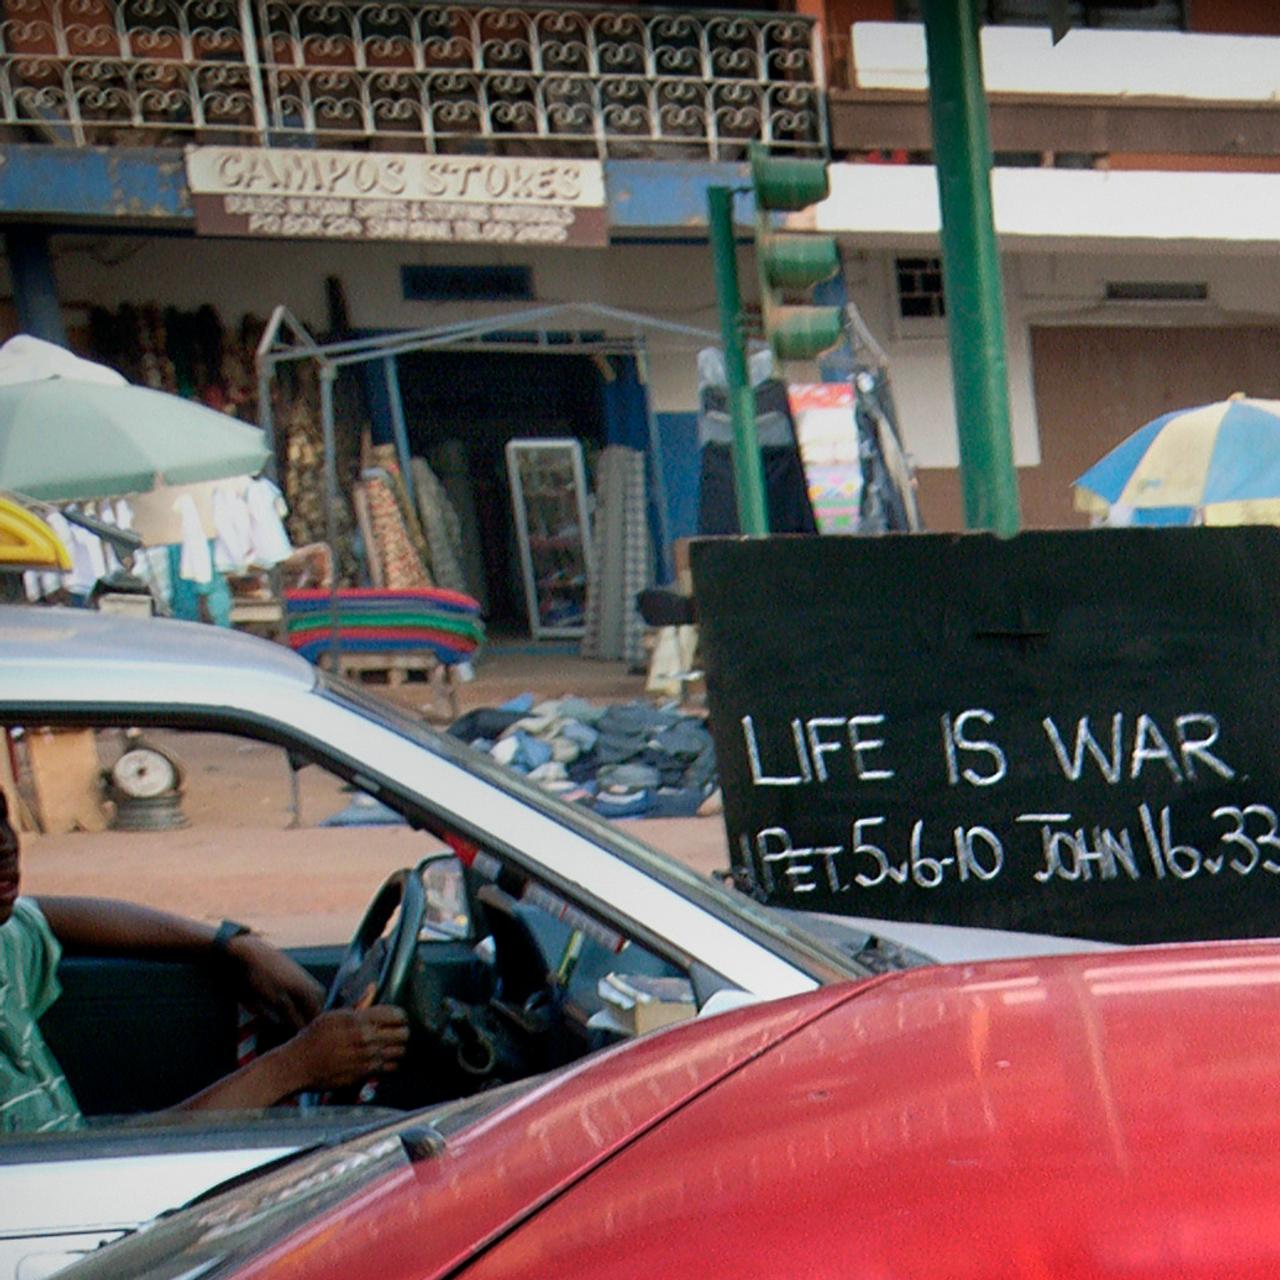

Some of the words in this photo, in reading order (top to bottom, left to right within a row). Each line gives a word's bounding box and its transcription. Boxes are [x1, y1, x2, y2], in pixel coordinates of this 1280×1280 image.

[218, 154, 406, 195] CAMPOS
[741, 714, 895, 786] LIFE
[941, 709, 1007, 787] IS
[1015, 813, 1139, 882] JOHN
